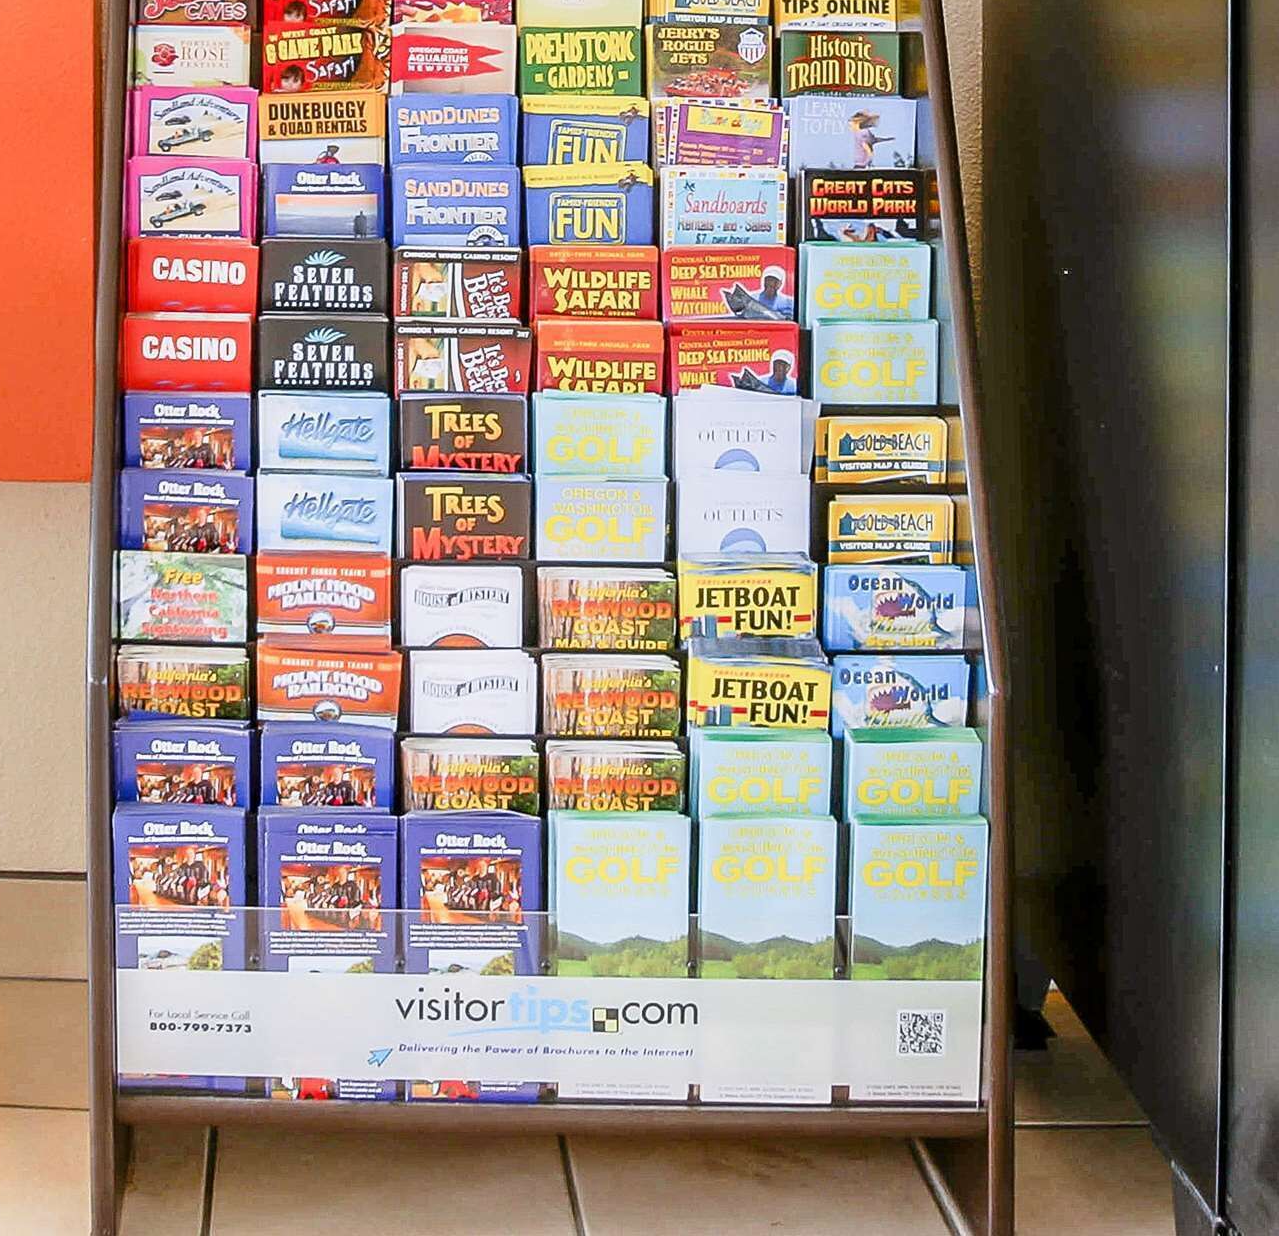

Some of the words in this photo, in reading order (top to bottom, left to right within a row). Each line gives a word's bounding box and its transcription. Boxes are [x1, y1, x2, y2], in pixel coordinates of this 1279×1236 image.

[187, 2, 247, 20] CAVES
[783, 0, 819, 16] TIPS
[826, 0, 890, 15] ONLINE
[657, 27, 721, 40] JERRY'S
[182, 47, 227, 61] ROSE
[525, 30, 636, 65] PREHISTORIC
[662, 40, 715, 52] ROGUE
[810, 34, 872, 61] Historic
[408, 55, 469, 63] AQUARIUM
[670, 52, 708, 65] JETS
[548, 65, 613, 88] GARDENS
[787, 60, 841, 92] TRAIN
[844, 59, 894, 92] RIDES
[268, 101, 366, 120] DUNEBUGGY
[280, 121, 313, 135] QUAD
[316, 120, 367, 134] RENTALS
[400, 127, 498, 153] FRONTIER
[556, 135, 619, 164] FUN
[811, 178, 867, 197] GREAT
[872, 178, 914, 195] CATS
[405, 199, 507, 225] FRONTIER
[684, 191, 768, 215] Sandboards
[810, 197, 868, 215] WORLD
[553, 208, 619, 239] FUN
[152, 257, 246, 285] CASINO
[293, 266, 354, 284] SEVEN
[543, 268, 651, 291] WILDLIFE
[670, 265, 696, 280] DEEP
[699, 265, 719, 279] SEA
[720, 264, 761, 279] FISHING
[274, 284, 373, 303] FEATHERS
[553, 289, 641, 312] SAFARI
[671, 286, 708, 300] WHALE
[815, 283, 922, 309] GOLF
[671, 301, 726, 316] WATCHING
[142, 336, 237, 361] CASINO
[292, 343, 354, 361] SEVEN
[678, 350, 704, 365] DEEP
[727, 348, 770, 363] FISHING
[548, 356, 657, 380] WILDLIFE
[820, 360, 928, 386] GOLF
[679, 371, 717, 386] WHALE
[281, 412, 376, 444] Hellgate
[424, 404, 503, 441] TREES
[454, 435, 475, 449] OF
[698, 428, 777, 444] OUTLETS
[545, 435, 654, 463] GOLF
[411, 445, 521, 473] MYSTERY
[281, 492, 377, 525] Hellgate
[424, 486, 505, 523] TREES
[703, 508, 785, 523] OUTLETS
[544, 516, 657, 542] GOLF
[412, 527, 524, 561] MYSTERY
[164, 568, 203, 586] Free
[847, 574, 904, 593] Ocean
[150, 588, 218, 603] Northern
[695, 586, 801, 609] JETBOAT
[899, 593, 954, 612] World
[148, 605, 220, 619] California
[734, 609, 792, 631] FUN!
[839, 668, 896, 687] Ocean
[711, 677, 819, 702] JETBOAT
[895, 683, 949, 703] World
[749, 702, 809, 724] FUN!
[149, 1021, 253, 1034] 800-799-7373
[399, 1043, 459, 1055] Delivering
[462, 1043, 480, 1053] the
[485, 1044, 523, 1055] Power
[543, 1046, 600, 1057] Brochures
[604, 1047, 616, 1057] to
[620, 1047, 640, 1057] the
